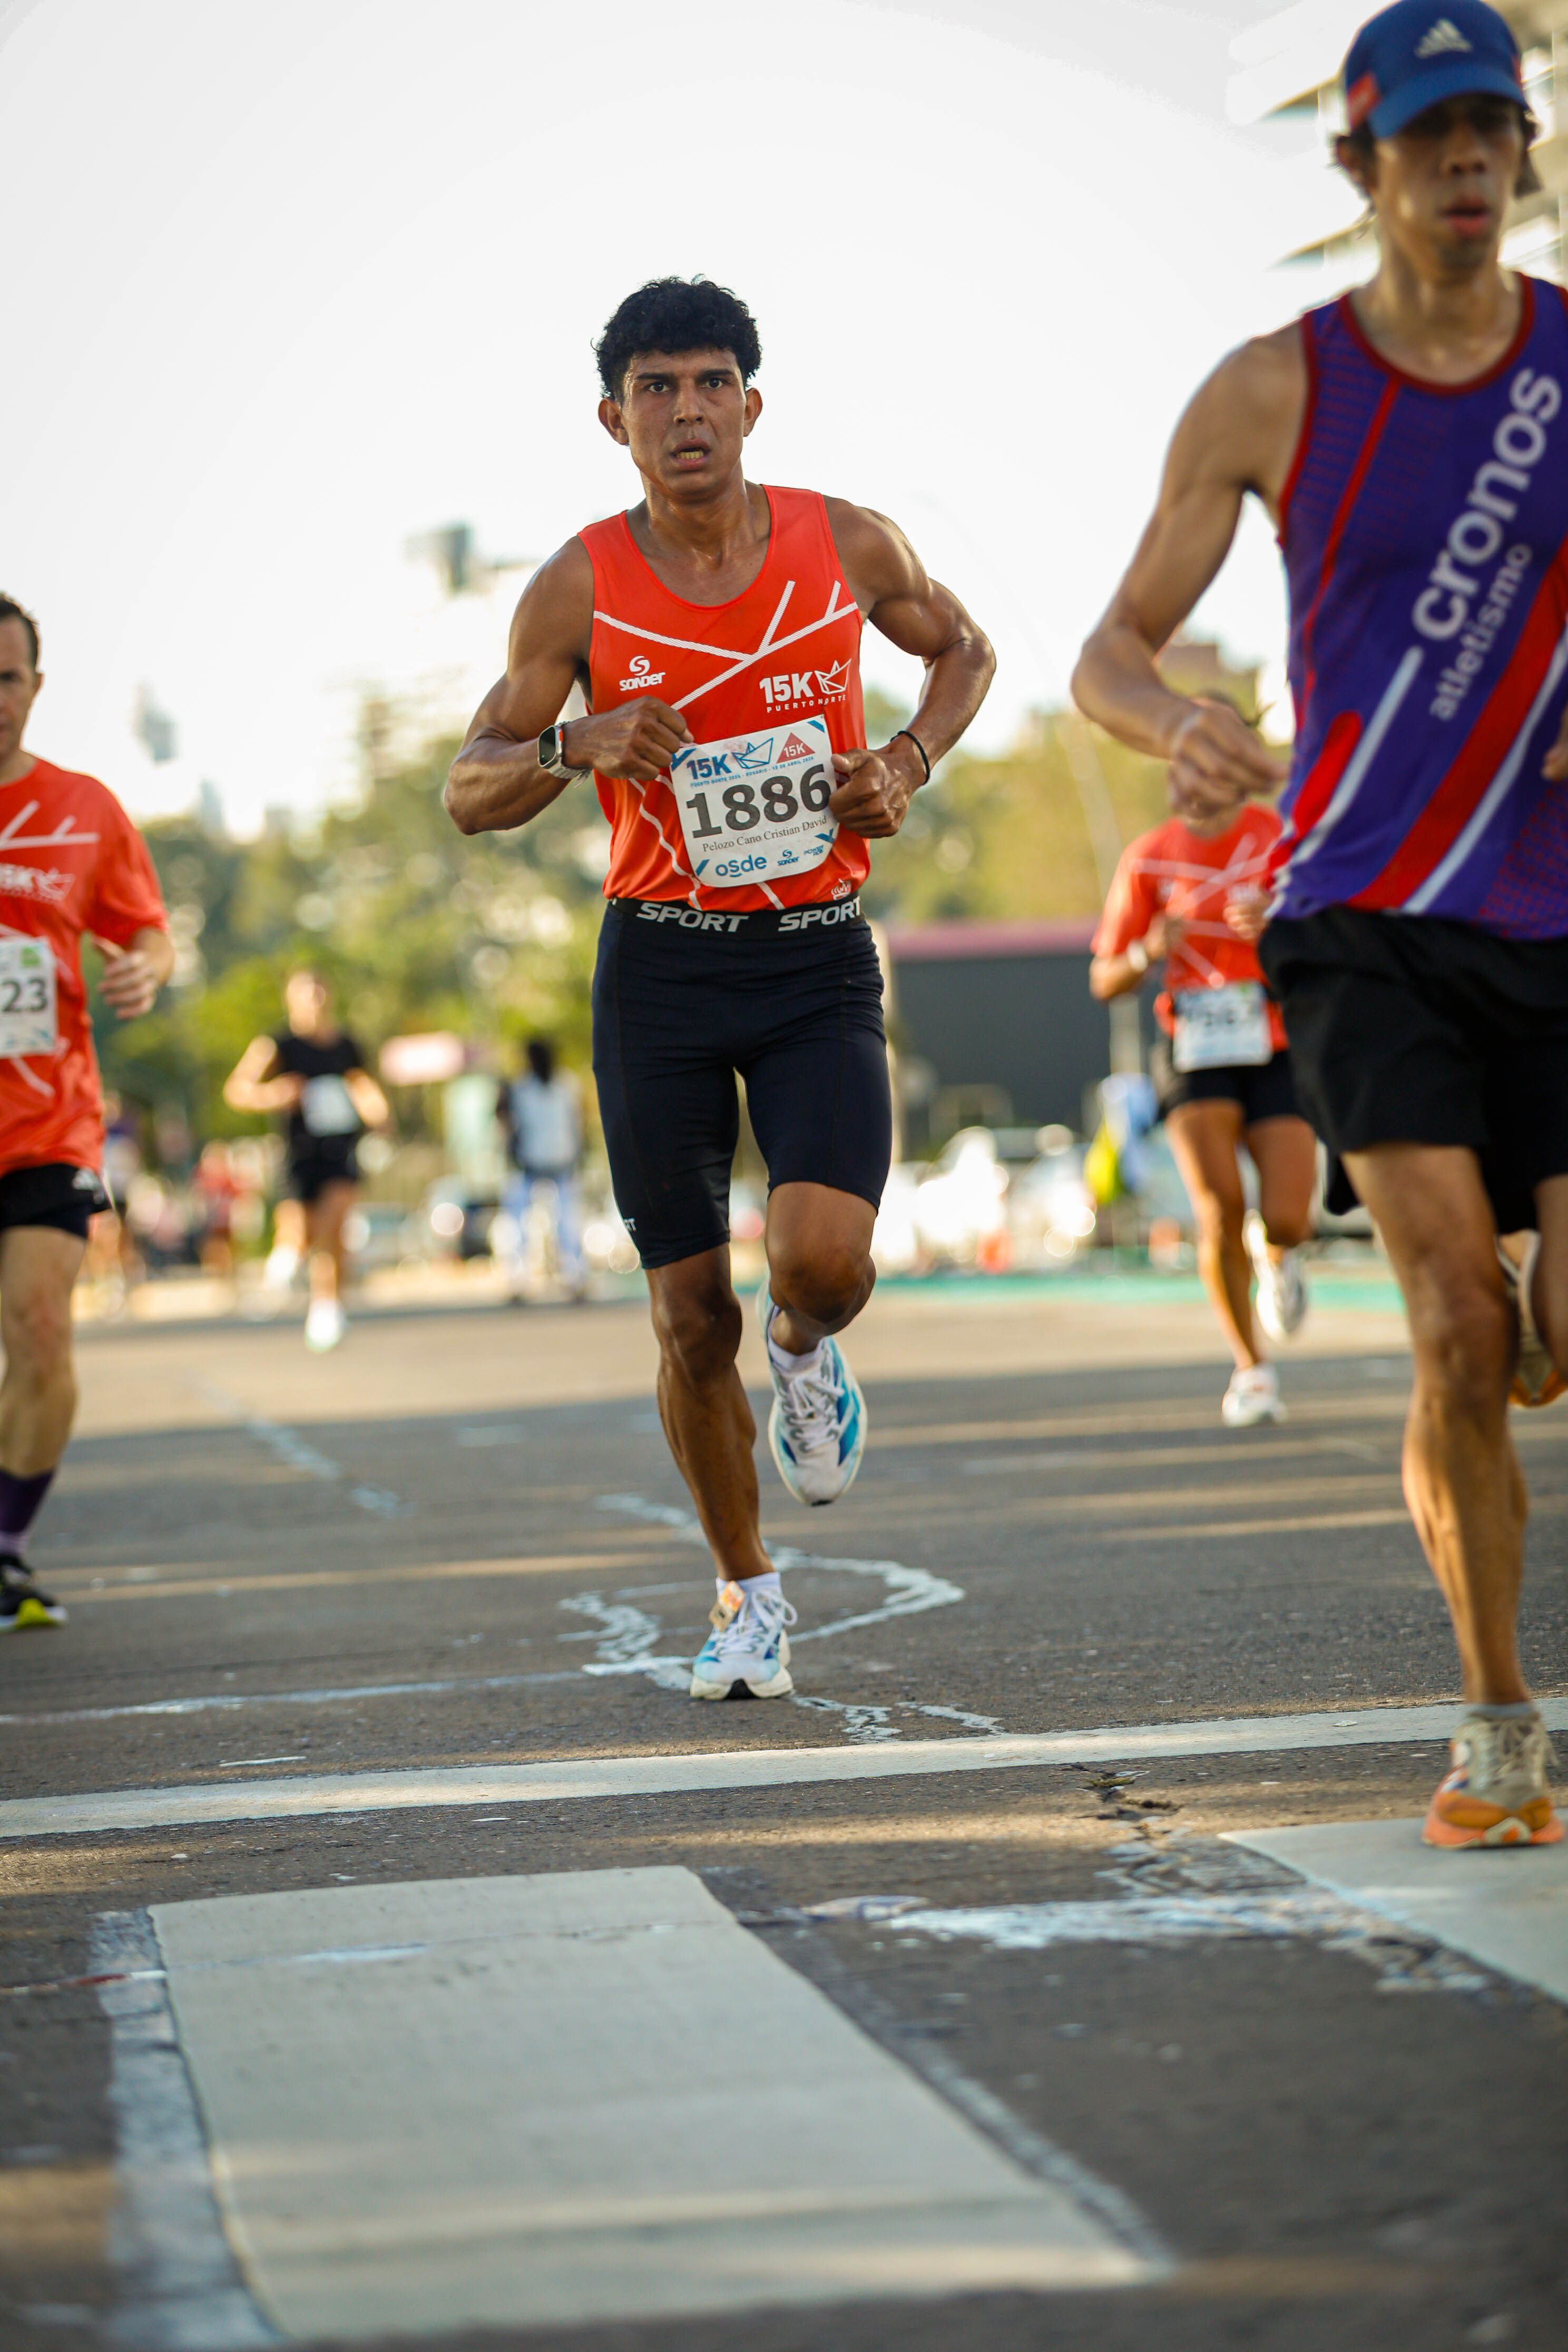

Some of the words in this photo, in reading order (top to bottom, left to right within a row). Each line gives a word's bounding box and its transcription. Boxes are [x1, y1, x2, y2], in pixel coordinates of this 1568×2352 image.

[1412, 368, 1562, 640] cronos
[1429, 544, 1532, 721] atletismo
[759, 671, 814, 703] 15K
[767, 700, 814, 713] PUERTO
[818, 694, 846, 705] NORTE
[687, 753, 732, 780] 15K
[783, 743, 806, 758] 15K
[686, 764, 831, 838] 1886
[702, 840, 734, 852] Pelozo
[737, 836, 761, 847] Cano
[764, 828, 800, 840] Cristian
[802, 815, 827, 831] David
[715, 854, 767, 877] osde
[636, 901, 749, 933] SPORT
[778, 896, 860, 932] SPORT
[0, 977, 48, 1013] 23
